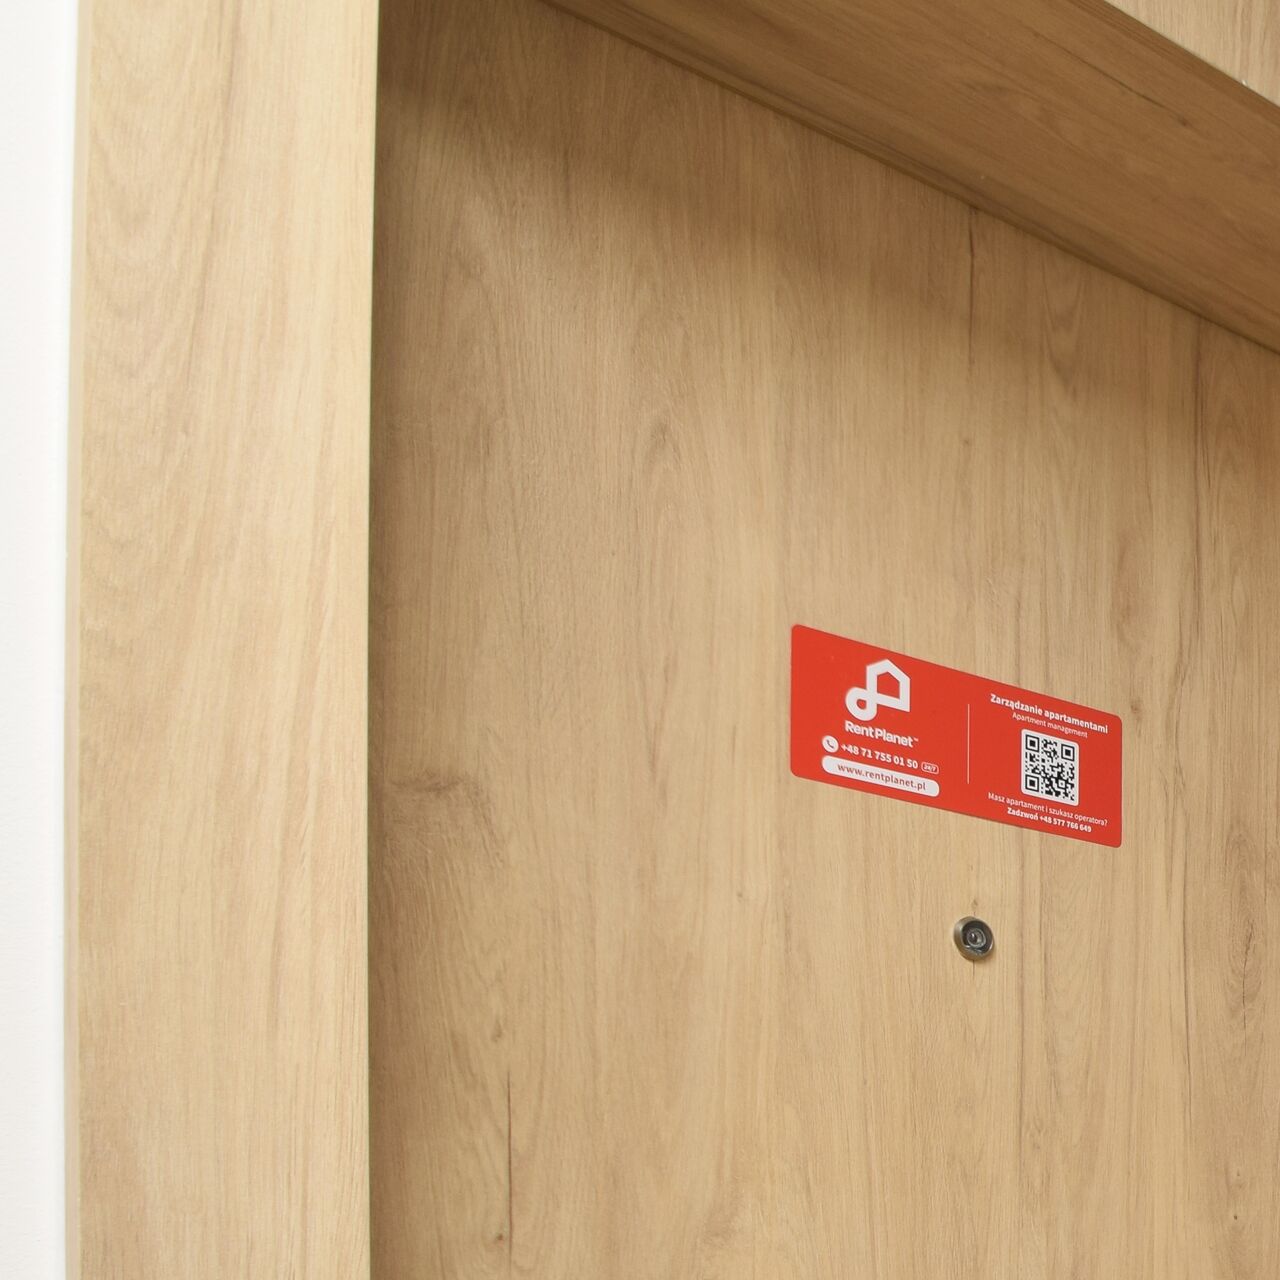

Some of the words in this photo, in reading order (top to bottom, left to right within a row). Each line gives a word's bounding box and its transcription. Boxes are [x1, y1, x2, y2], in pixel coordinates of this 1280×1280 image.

[990, 693, 1044, 716] Zarządzanie
[1044, 709, 1109, 734] apartamentami
[1012, 712, 1047, 727] Apartment
[1047, 722, 1088, 738] management
[841, 743, 860, 756] +48
[860, 747, 874, 759] 71
[874, 750, 892, 764] 755
[892, 755, 906, 767] 01
[906, 759, 919, 770] 50
[837, 764, 926, 790] www.rentplanet.pl
[988, 792, 1006, 804] Masz
[1006, 797, 1045, 813] apartament
[1048, 807, 1074, 819] szukasz
[1074, 814, 1108, 827] operatora?
[1007, 806, 1039, 821] Zadzwoń
[1039, 815, 1053, 824] +48
